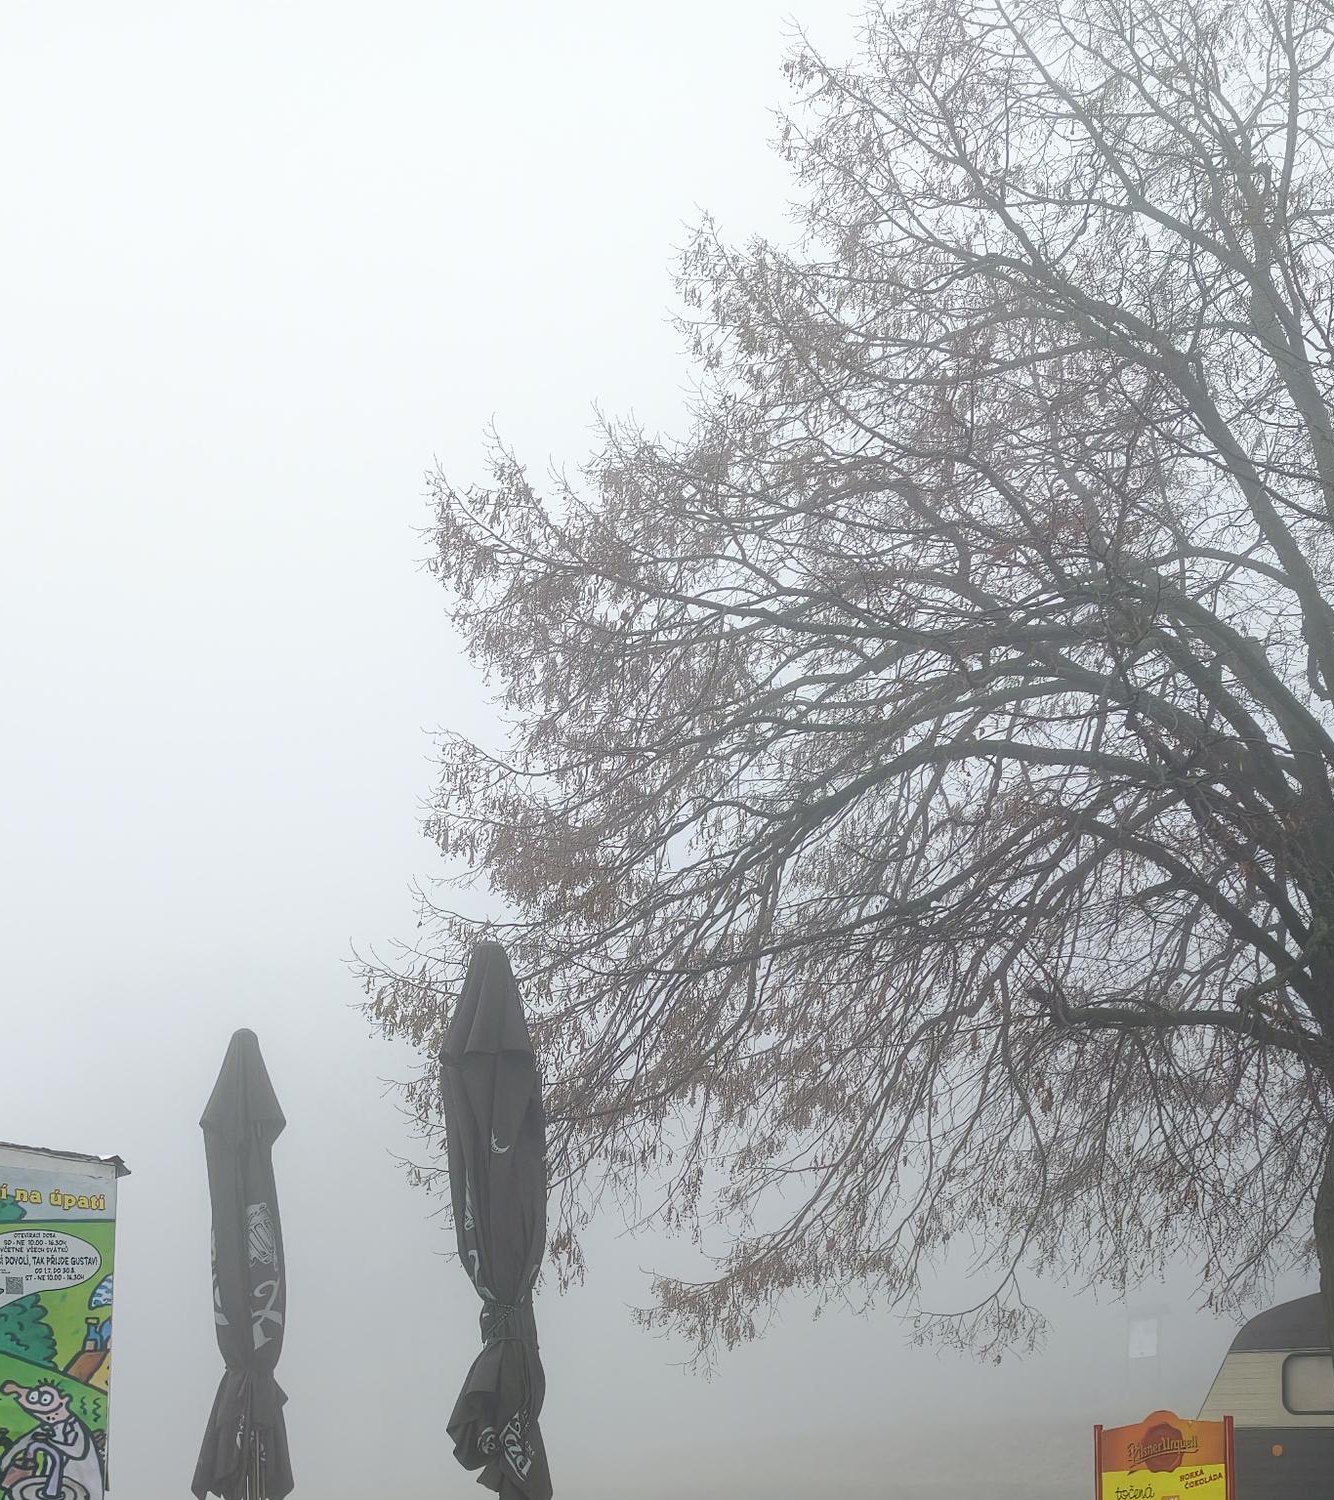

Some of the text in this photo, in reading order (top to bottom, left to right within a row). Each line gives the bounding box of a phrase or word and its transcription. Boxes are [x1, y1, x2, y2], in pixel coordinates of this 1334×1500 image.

[15, 1188, 42, 1204] na
[49, 1188, 106, 1211] úpatí
[32, 1256, 45, 1266] TAK
[1127, 1436, 1198, 1463] Pilsner Urquell
